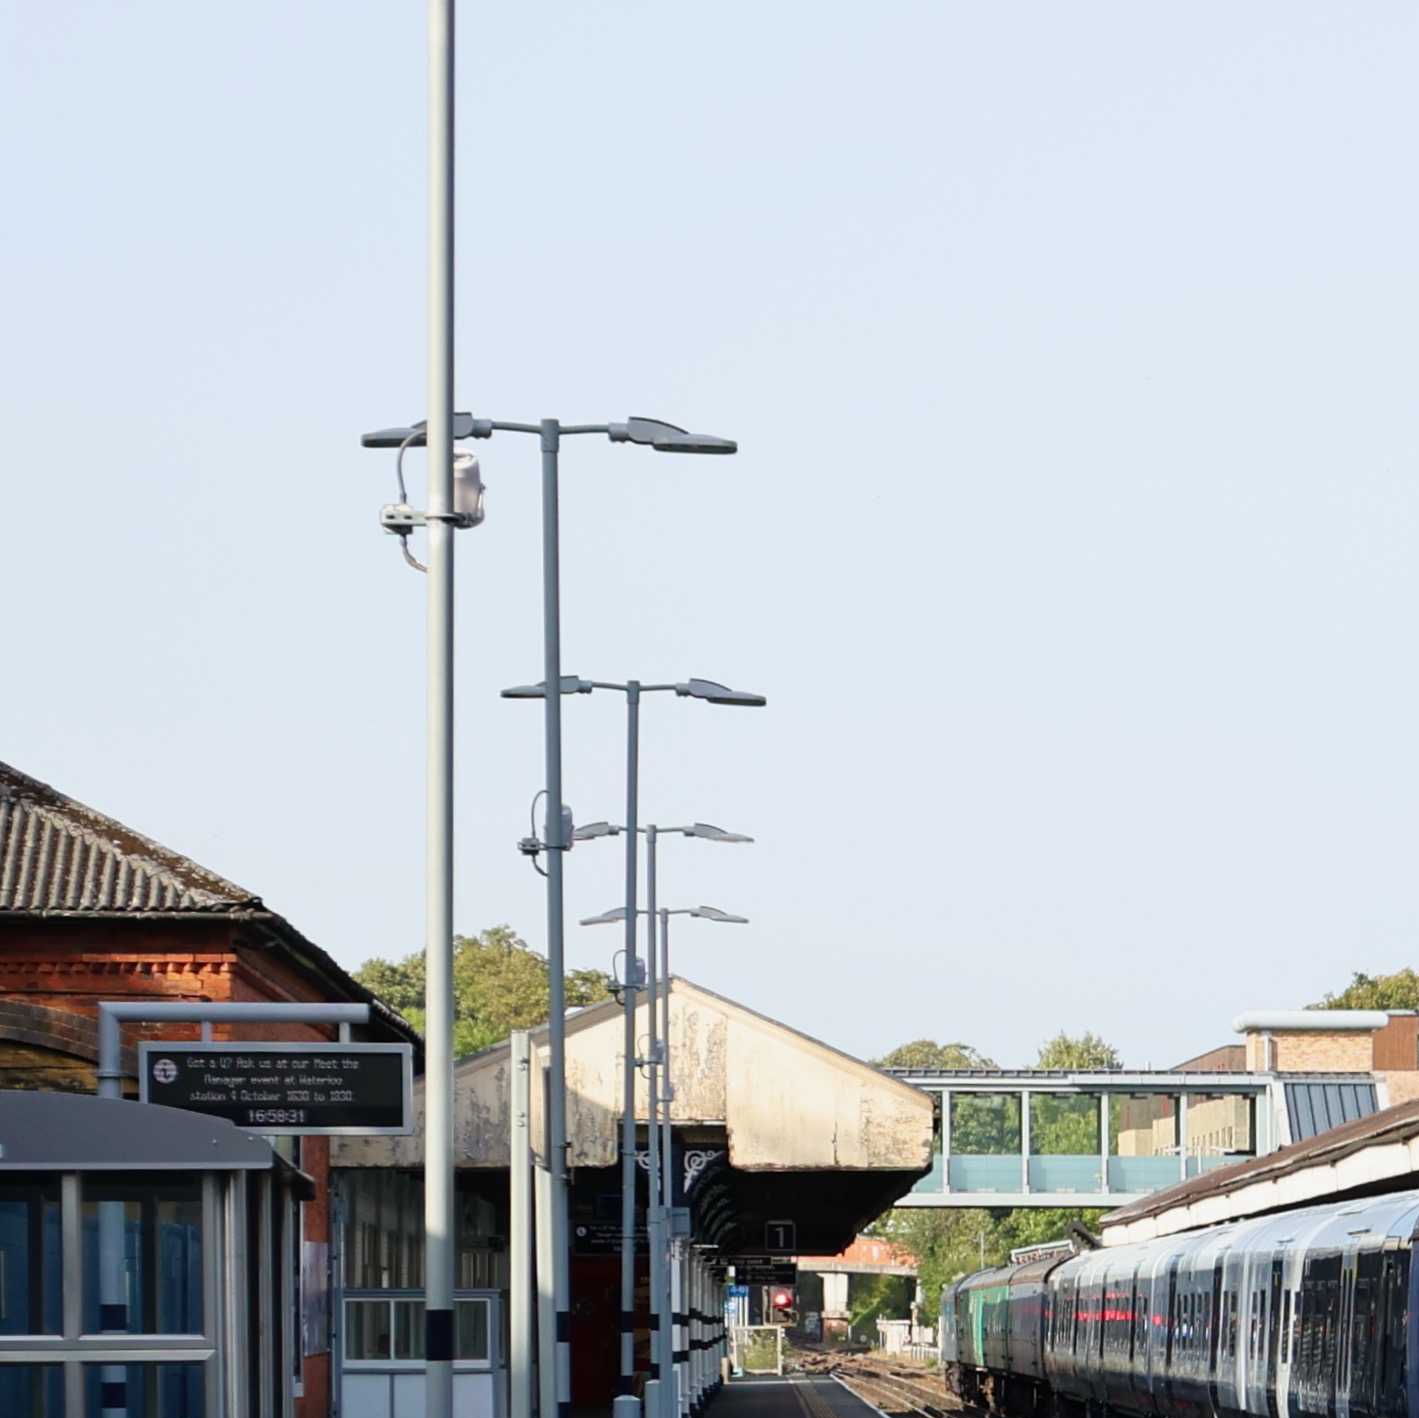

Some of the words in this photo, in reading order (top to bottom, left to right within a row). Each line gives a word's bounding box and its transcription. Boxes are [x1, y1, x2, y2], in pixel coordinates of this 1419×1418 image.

[209, 1059, 217, 1069] a
[236, 1057, 255, 1069] Ask
[259, 1059, 272, 1069] us
[275, 1058, 287, 1069] at
[292, 1059, 309, 1069] our
[314, 1058, 338, 1069] Meet
[342, 1057, 359, 1069] the
[204, 1074, 247, 1088] Manager
[250, 1075, 279, 1086] event
[284, 1075, 296, 1086] at
[299, 1074, 343, 1086] Waterloo
[190, 1090, 226, 1102] station
[240, 1089, 281, 1102] October
[313, 1090, 325, 1102] to
[248, 1109, 305, 1123] 16:58:31
[775, 1226, 785, 1248] 1
